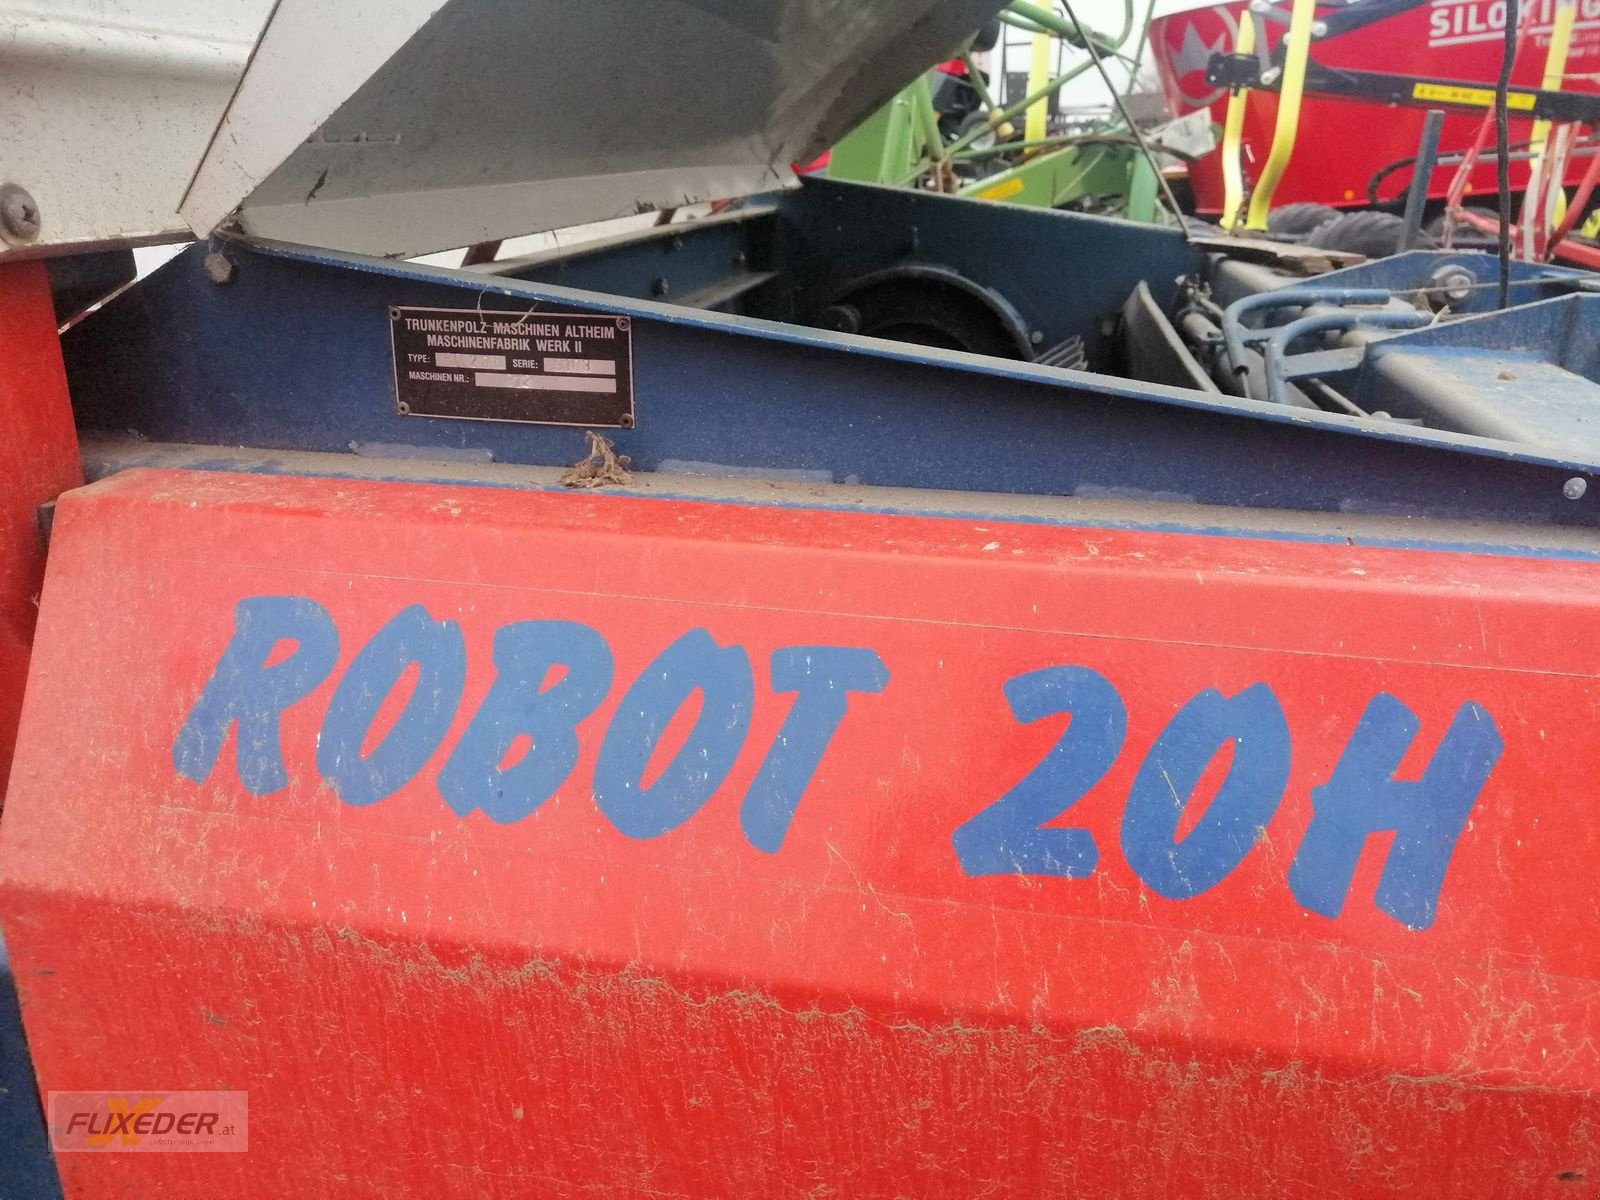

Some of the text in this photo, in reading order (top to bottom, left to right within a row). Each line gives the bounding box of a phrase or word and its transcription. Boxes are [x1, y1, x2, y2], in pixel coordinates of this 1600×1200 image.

[1429, 0, 1600, 38] SILOKIG
[405, 319, 615, 339] TRUNKENPOLZ MASCHINEN ALTHEIM
[427, 334, 582, 353] MASCHINENFABRIK WERK II
[408, 354, 430, 364] TYPE:
[512, 359, 538, 369] SERIE:
[409, 371, 453, 383] MASCHINEN
[172, 595, 1505, 931] ROBOT 20H
